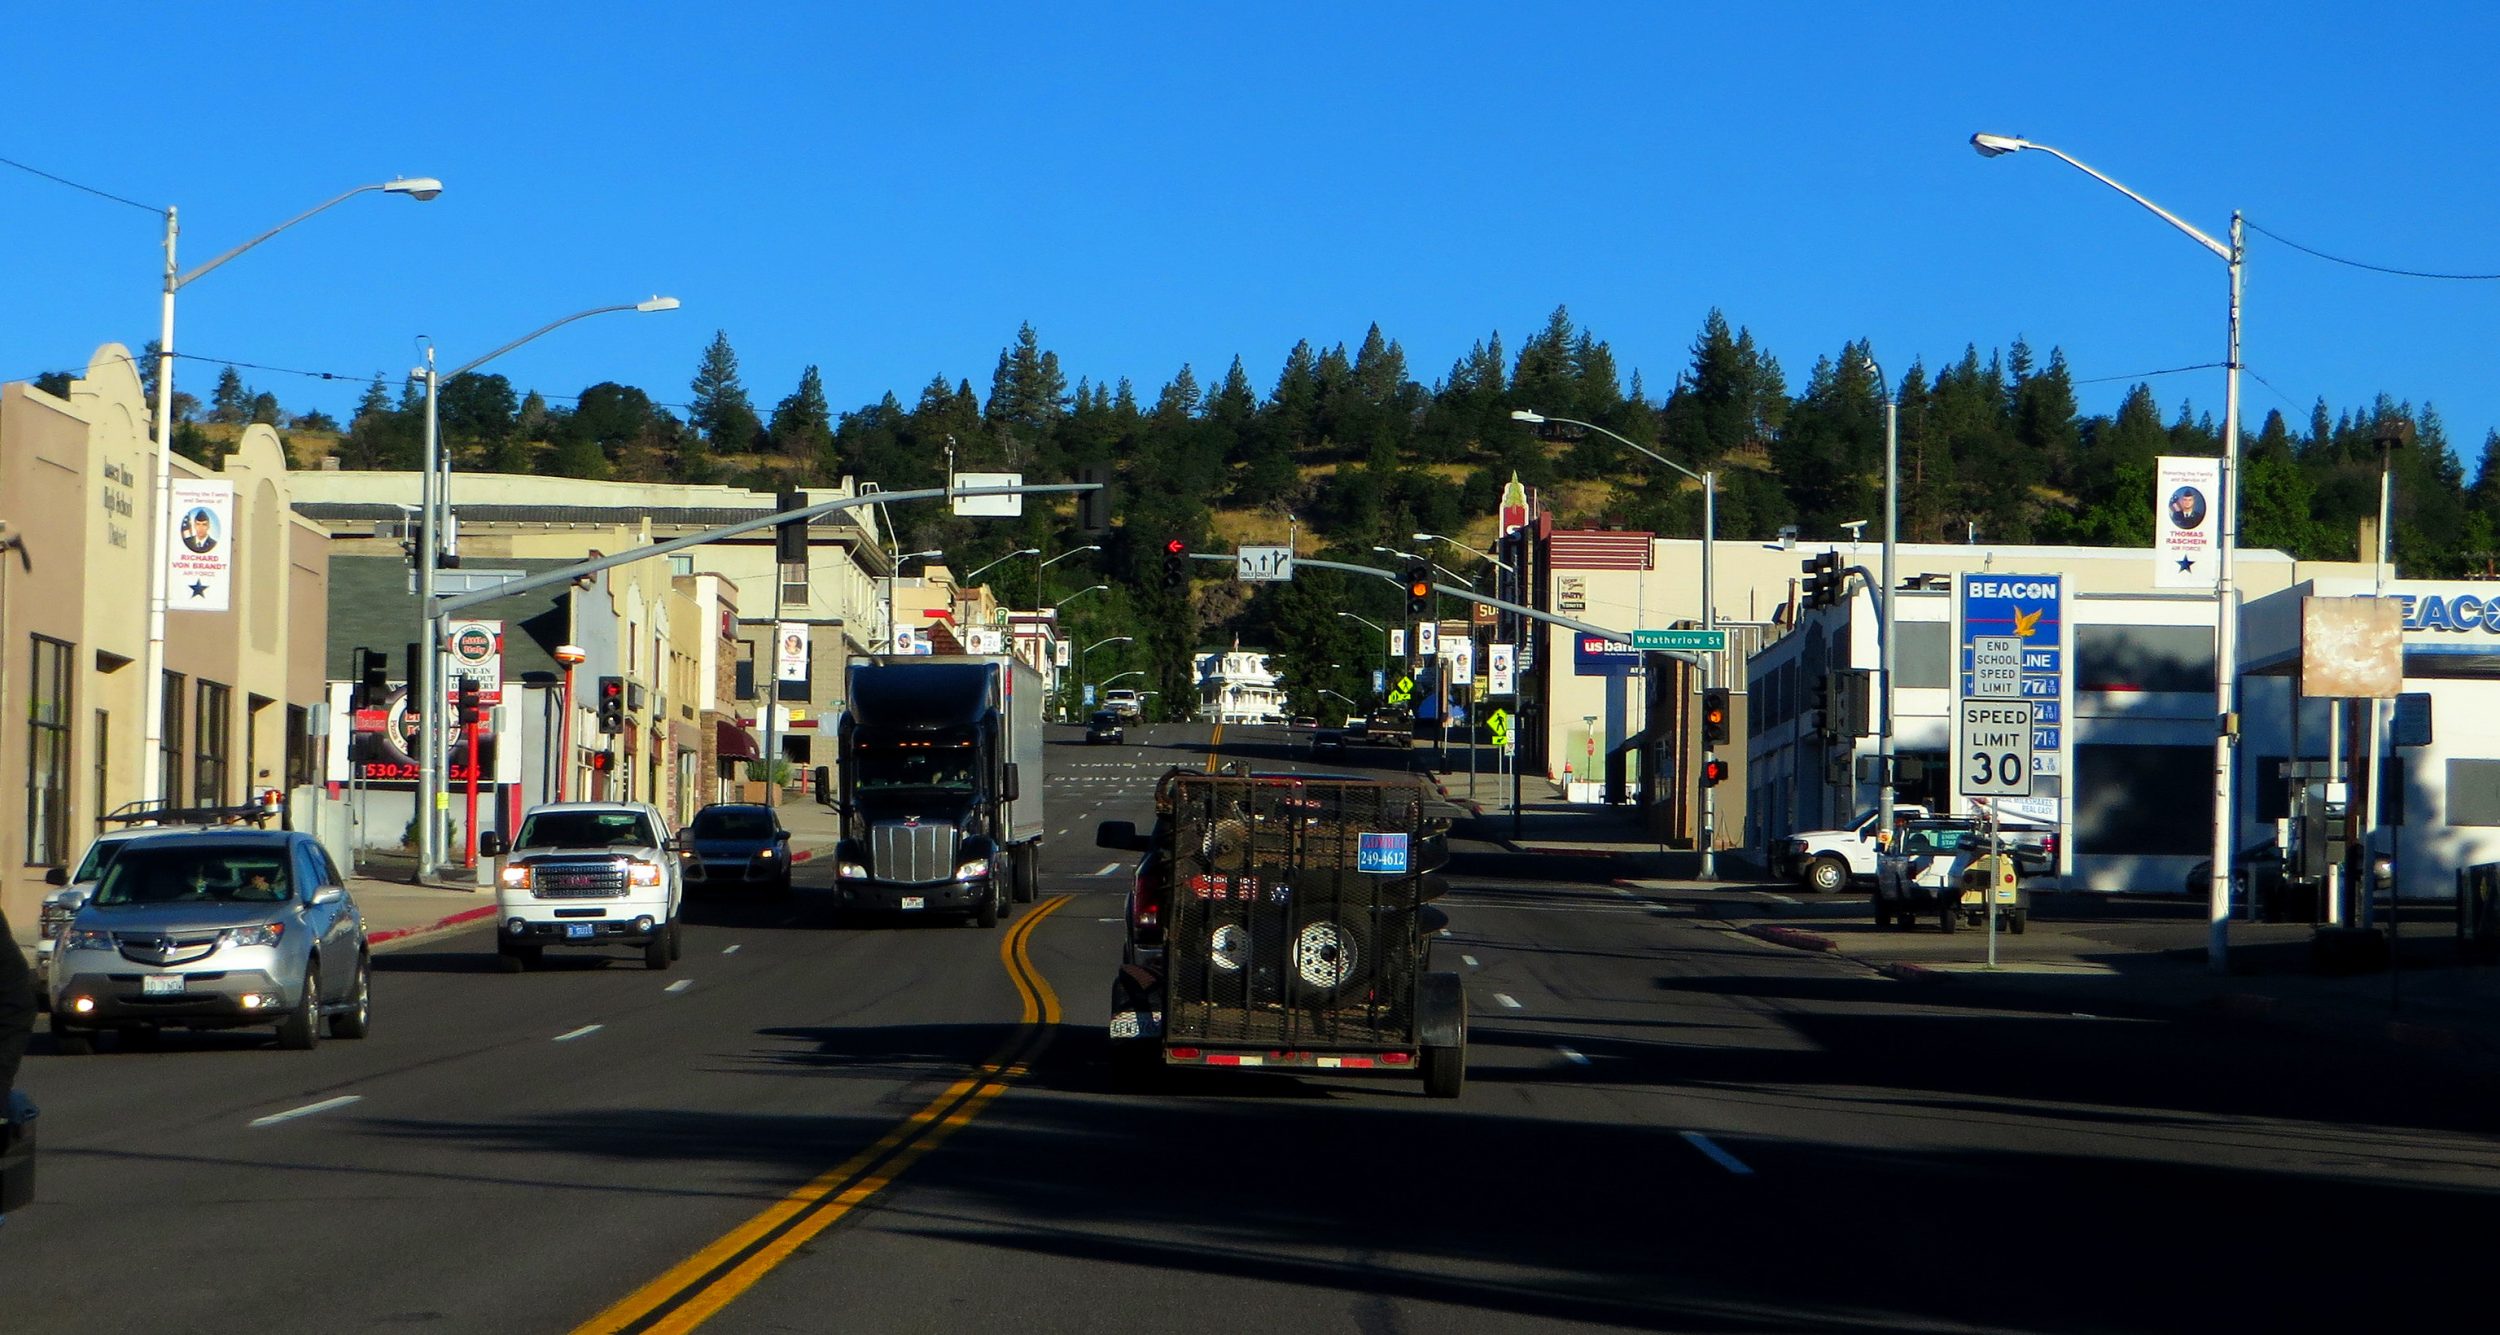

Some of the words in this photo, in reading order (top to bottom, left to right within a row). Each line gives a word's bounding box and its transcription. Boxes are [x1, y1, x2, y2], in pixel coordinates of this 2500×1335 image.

[1969, 582, 2056, 599] BEACON
[1480, 605, 1499, 617] SU
[462, 636, 487, 644] Little
[1637, 635, 1700, 645] Weatherlow
[1708, 636, 1721, 645] St
[1987, 641, 2009, 651] END
[1977, 655, 2019, 664] SCHOOL
[1980, 669, 2015, 678] SPEED
[1983, 683, 2012, 692] LIMIT
[1968, 710, 2027, 723] SPEED
[1973, 733, 2020, 746] LIMIT
[1971, 752, 2021, 785] 30
[1361, 850, 1404, 866] 249-4612
